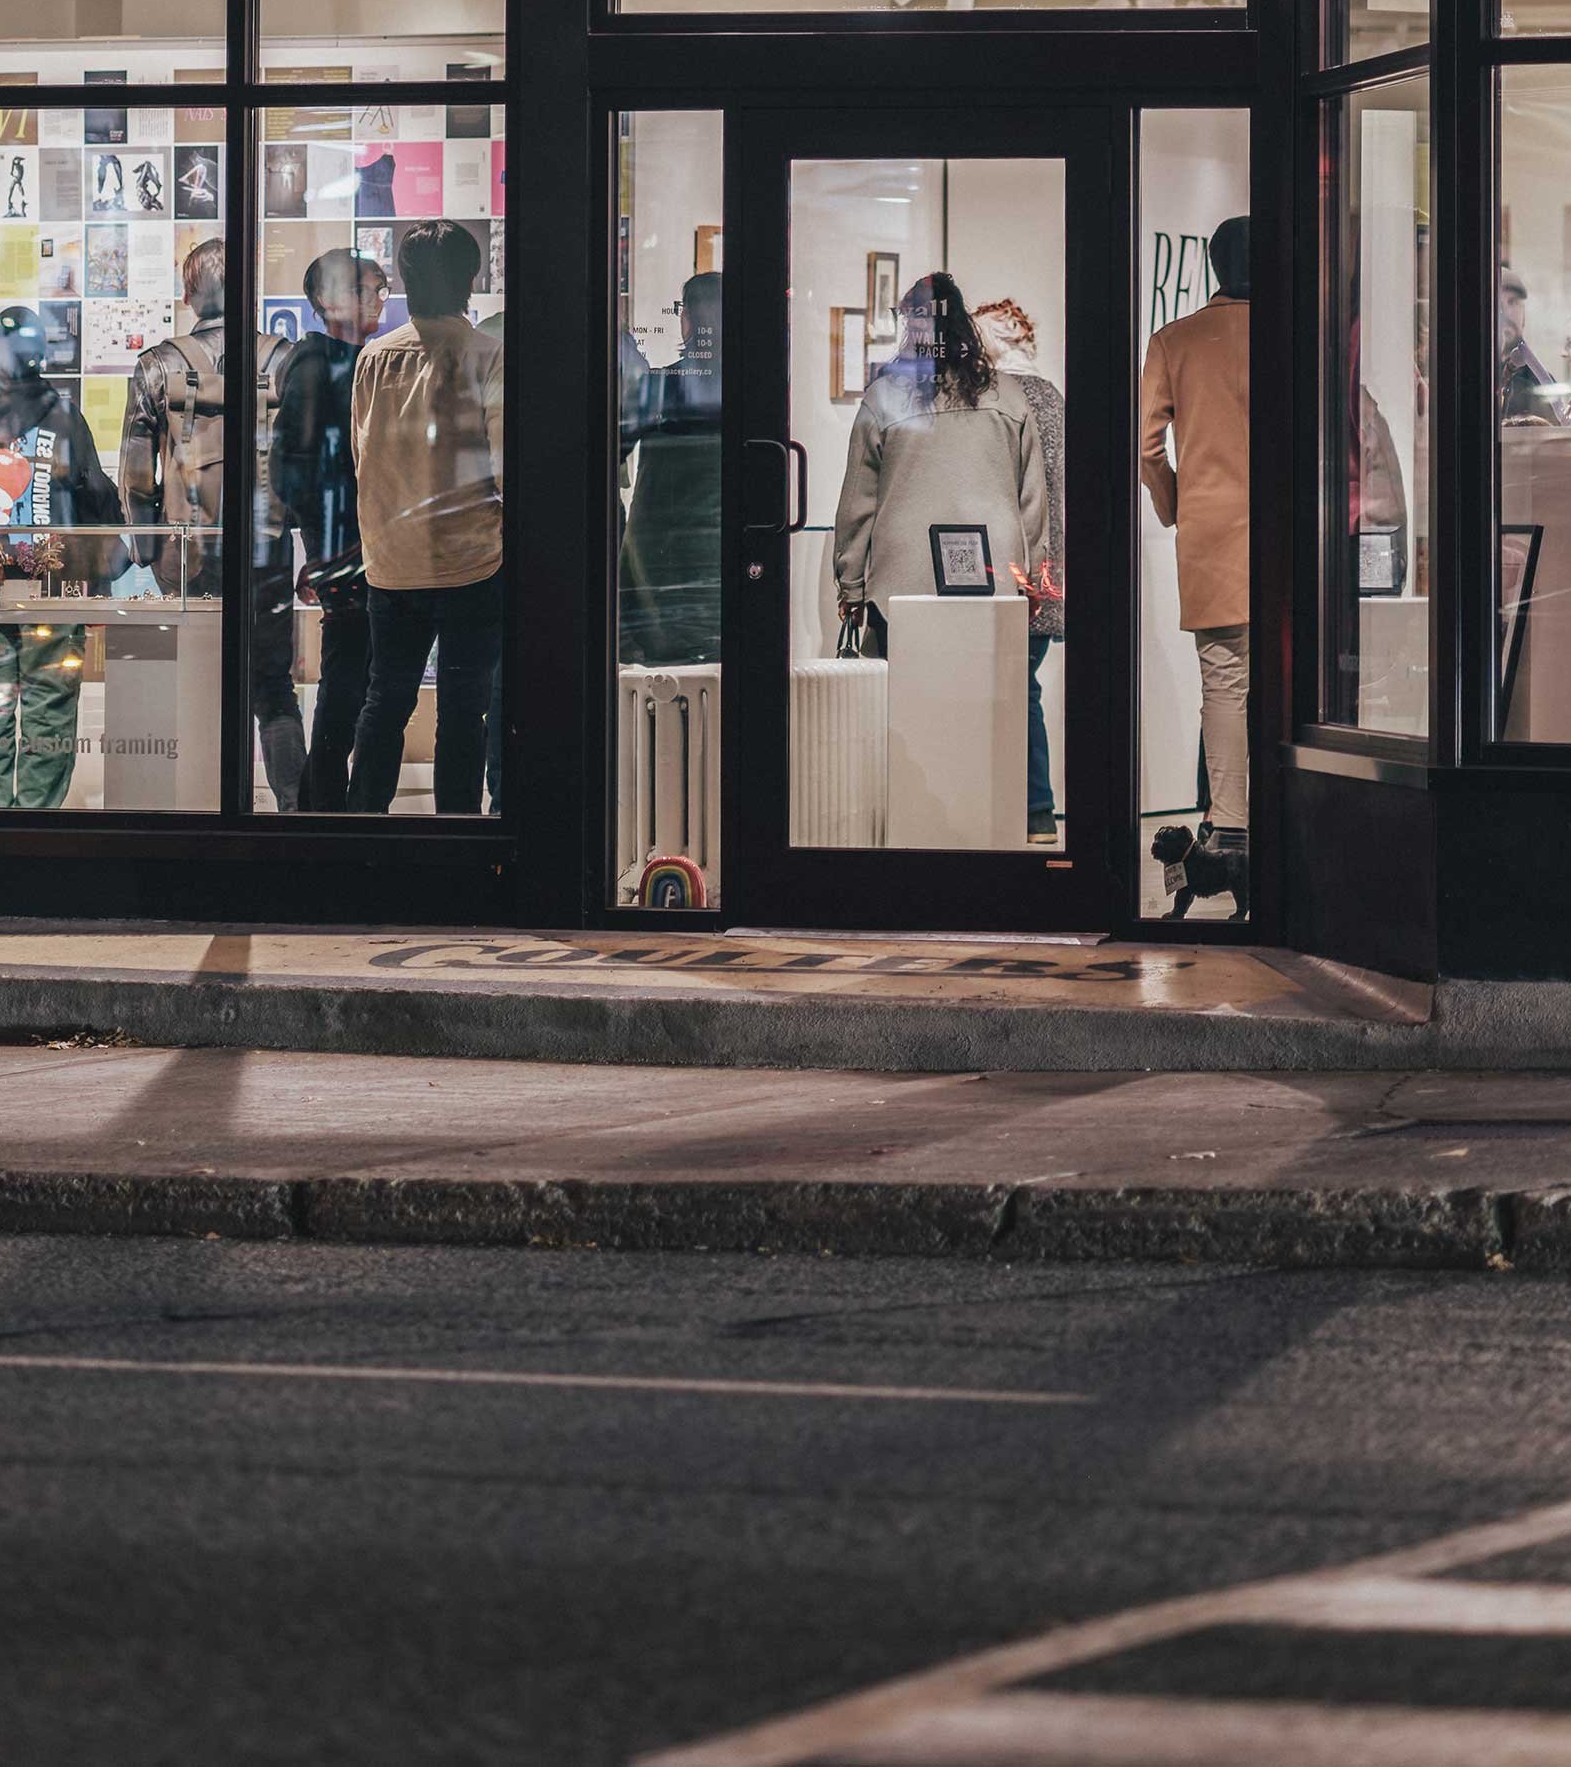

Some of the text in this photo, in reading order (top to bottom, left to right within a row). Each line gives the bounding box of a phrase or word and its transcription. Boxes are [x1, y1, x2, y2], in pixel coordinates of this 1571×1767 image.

[911, 332, 946, 345] WALL
[688, 351, 713, 359] CLOSED
[36, 429, 56, 459] LES
[100, 733, 179, 760] framing
